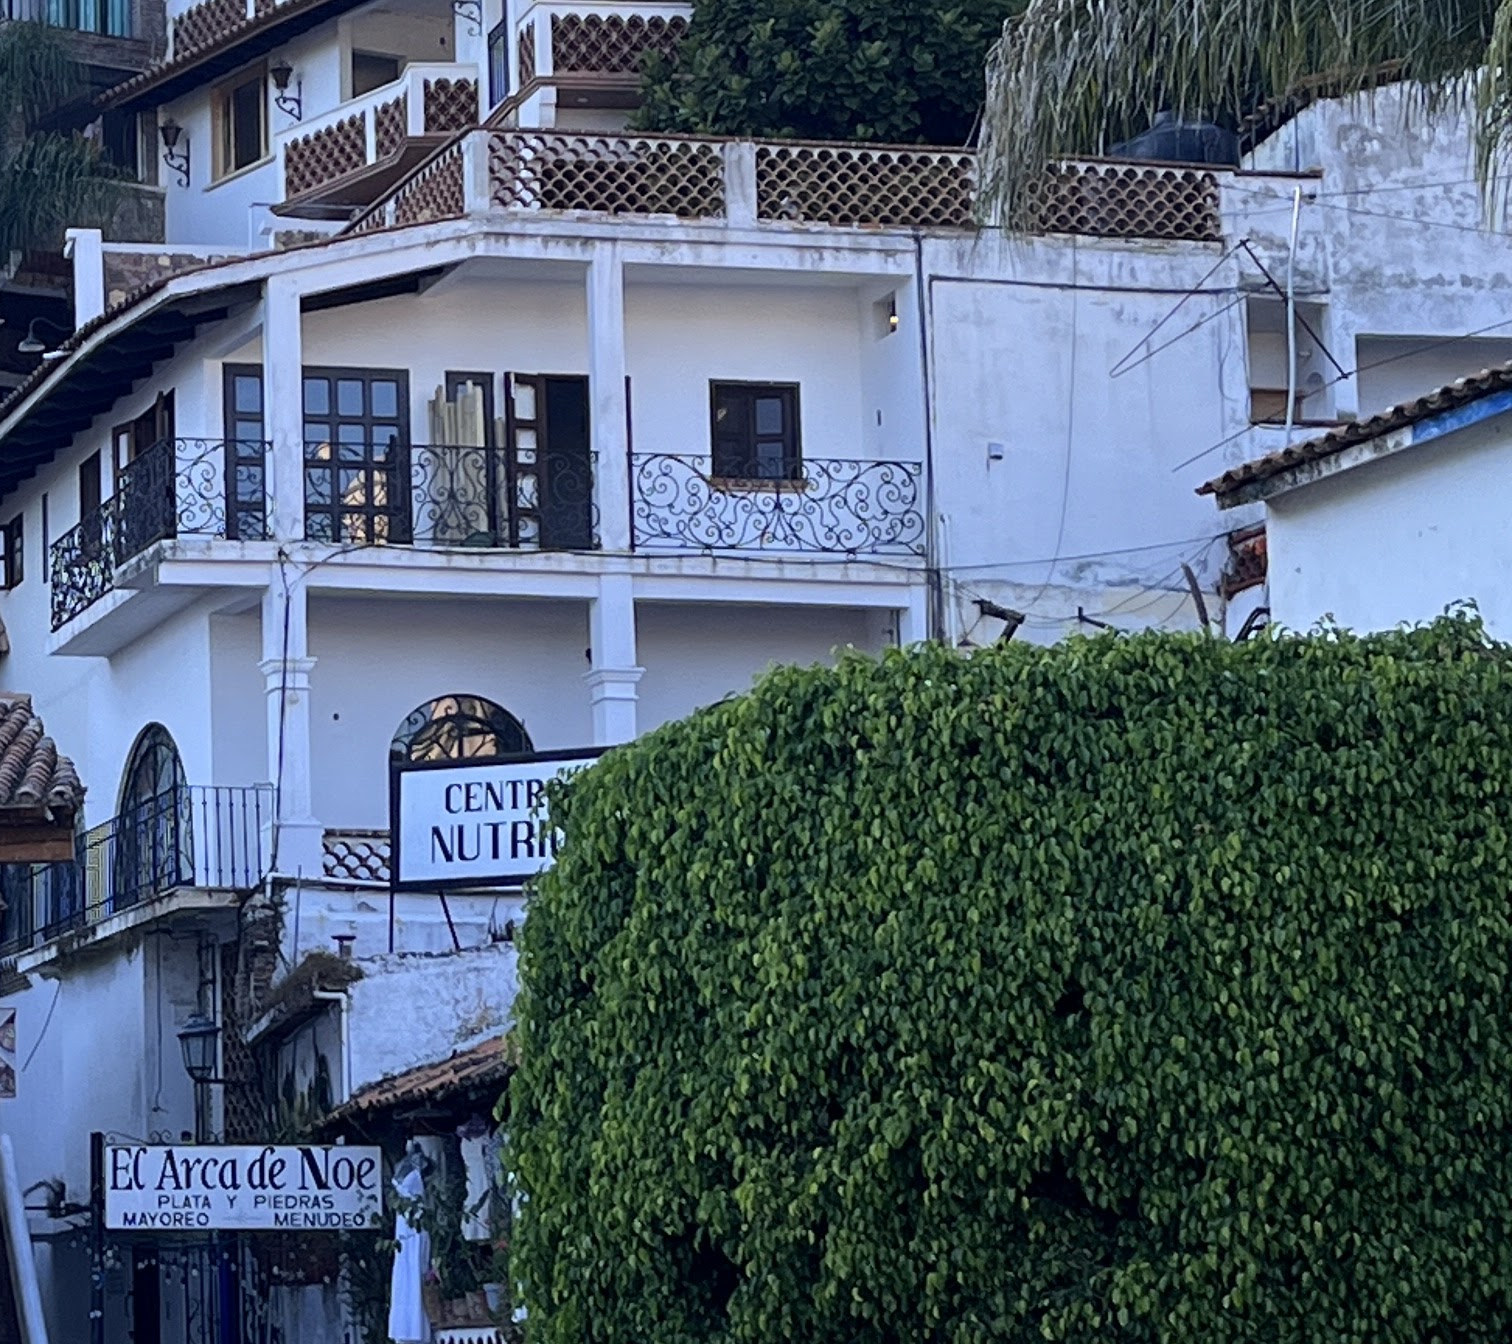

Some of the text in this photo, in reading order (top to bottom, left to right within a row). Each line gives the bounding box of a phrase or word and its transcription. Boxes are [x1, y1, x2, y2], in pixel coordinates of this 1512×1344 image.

[445, 777, 563, 814] CENTR
[110, 1146, 376, 1191] El Arca de Noe
[157, 1194, 335, 1209] PLATA Y PIEDRAS
[122, 1211, 365, 1227] MAYOREO MENUDEO
